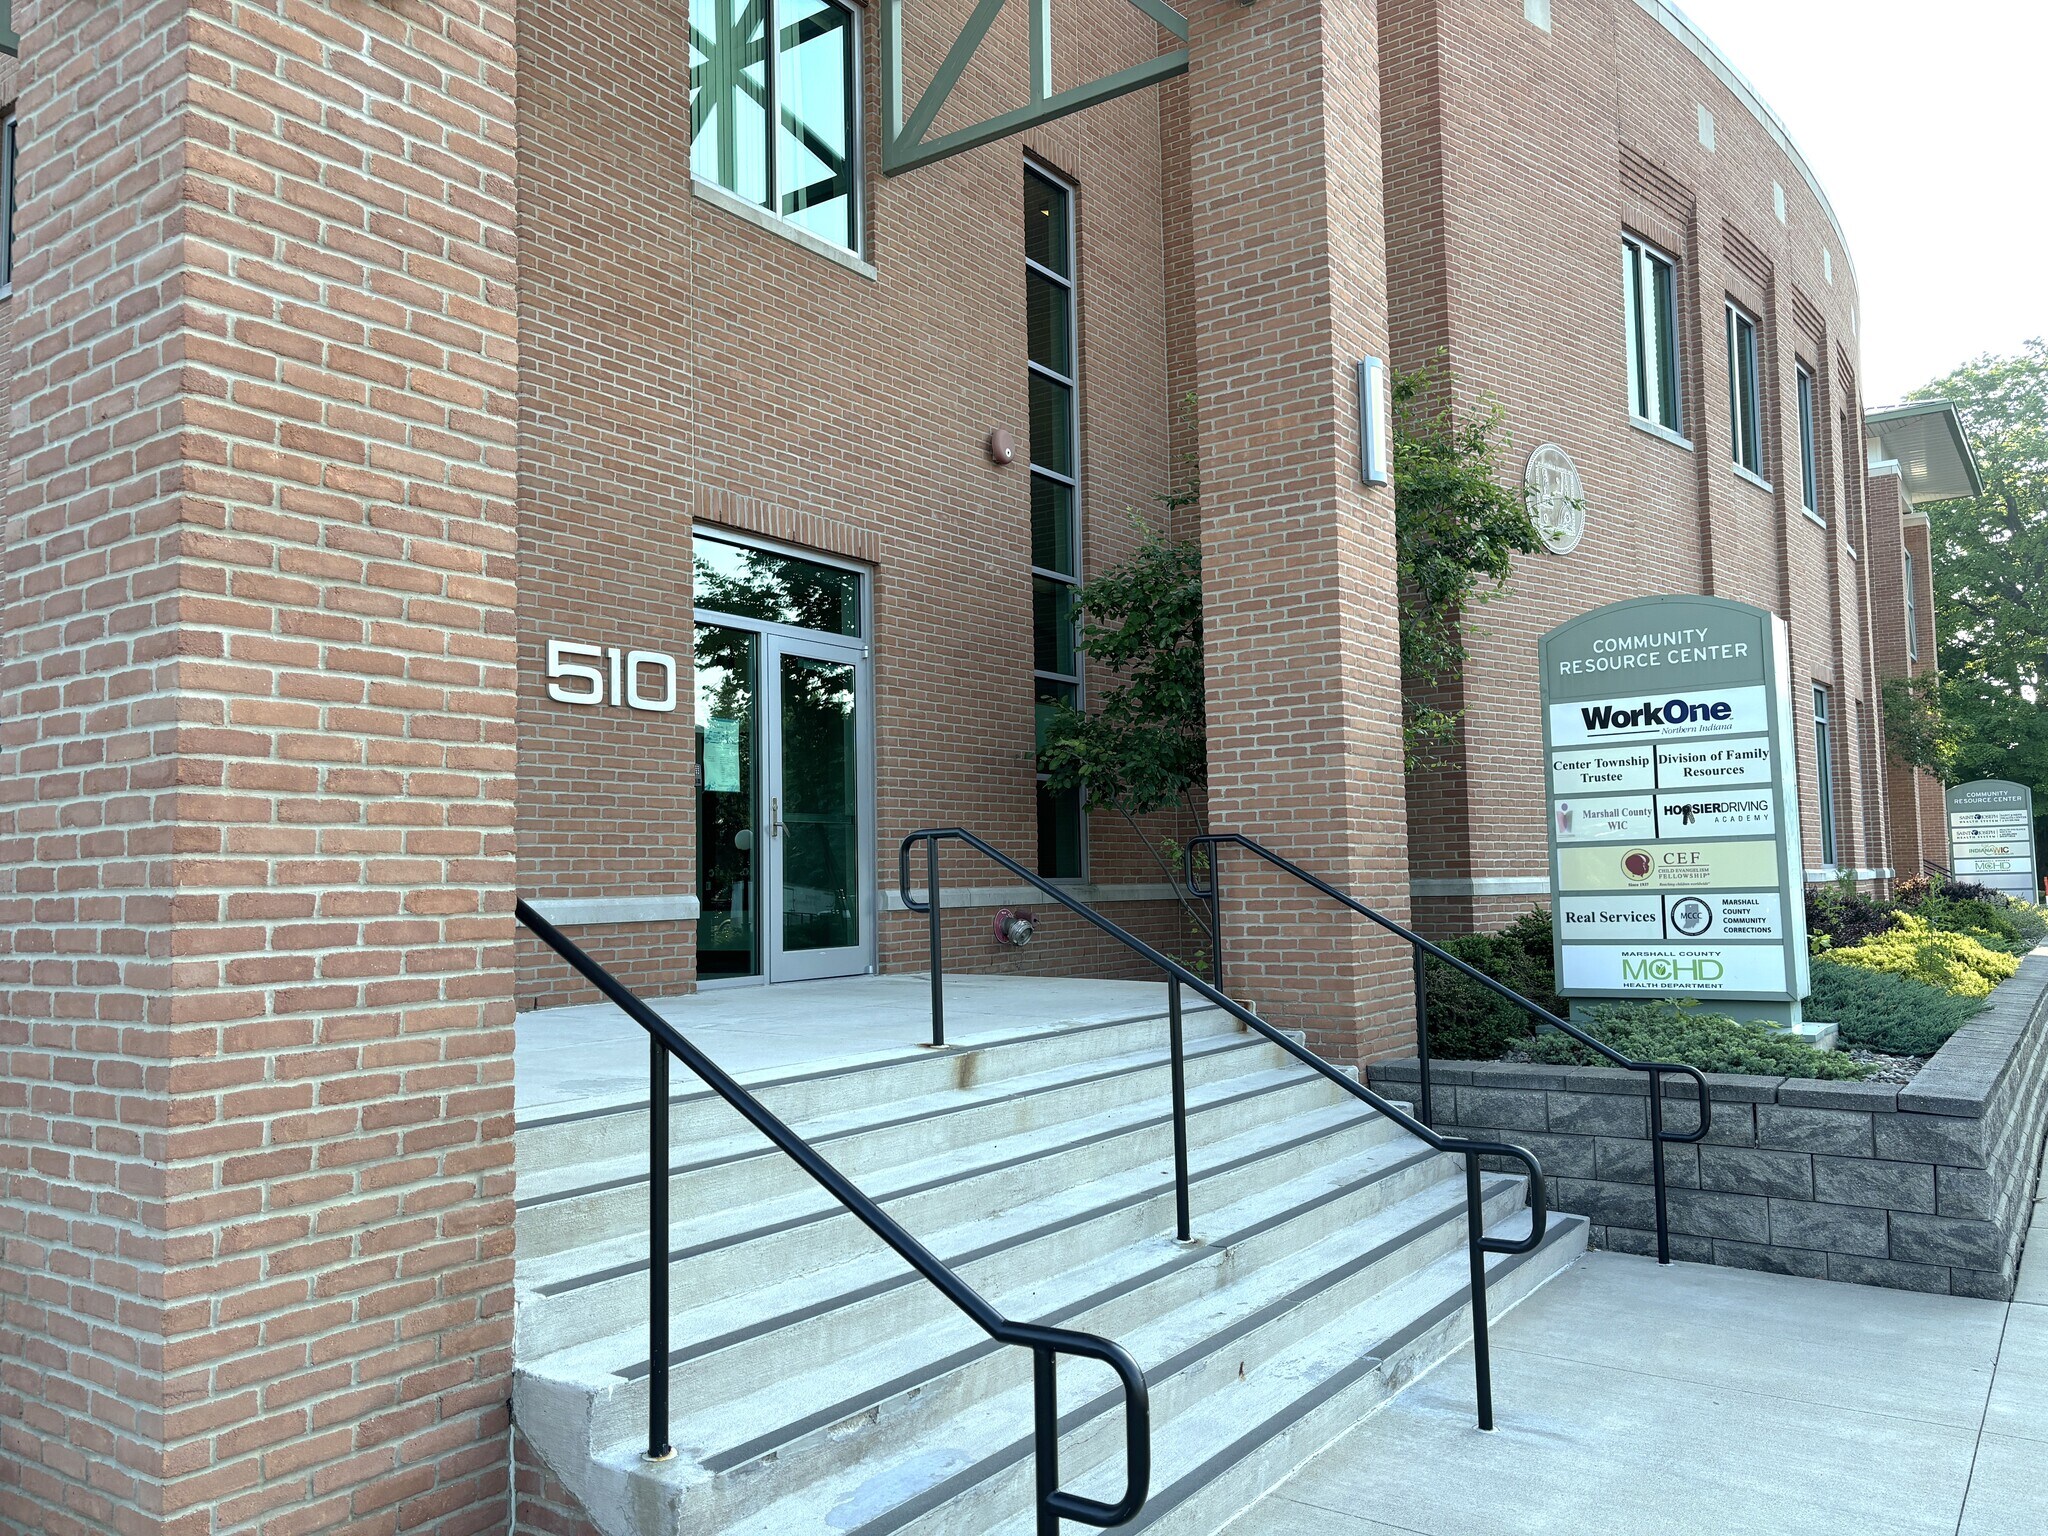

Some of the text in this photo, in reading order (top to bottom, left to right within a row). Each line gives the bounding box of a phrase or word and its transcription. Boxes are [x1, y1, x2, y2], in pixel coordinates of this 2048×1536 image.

[1593, 628, 1709, 654] COMMUNITY
[1560, 642, 1748, 675] RESOURCE CENTER
[546, 639, 677, 712] 510
[1581, 700, 1732, 730] WorkOne
[1661, 722, 1732, 735] Northern Indiana
[1658, 748, 1770, 765] Division of Family
[1554, 756, 1650, 771] Center Township
[1580, 772, 1623, 783] Trustee
[1683, 765, 1744, 778] Resources
[1582, 808, 1652, 820] Marshall County
[1714, 814, 1768, 823] ACADEMY
[1608, 820, 1628, 830] WIC
[1663, 852, 1701, 865] CEF
[1566, 911, 1656, 923] Real Services
[1623, 959, 1723, 980] MCHD
